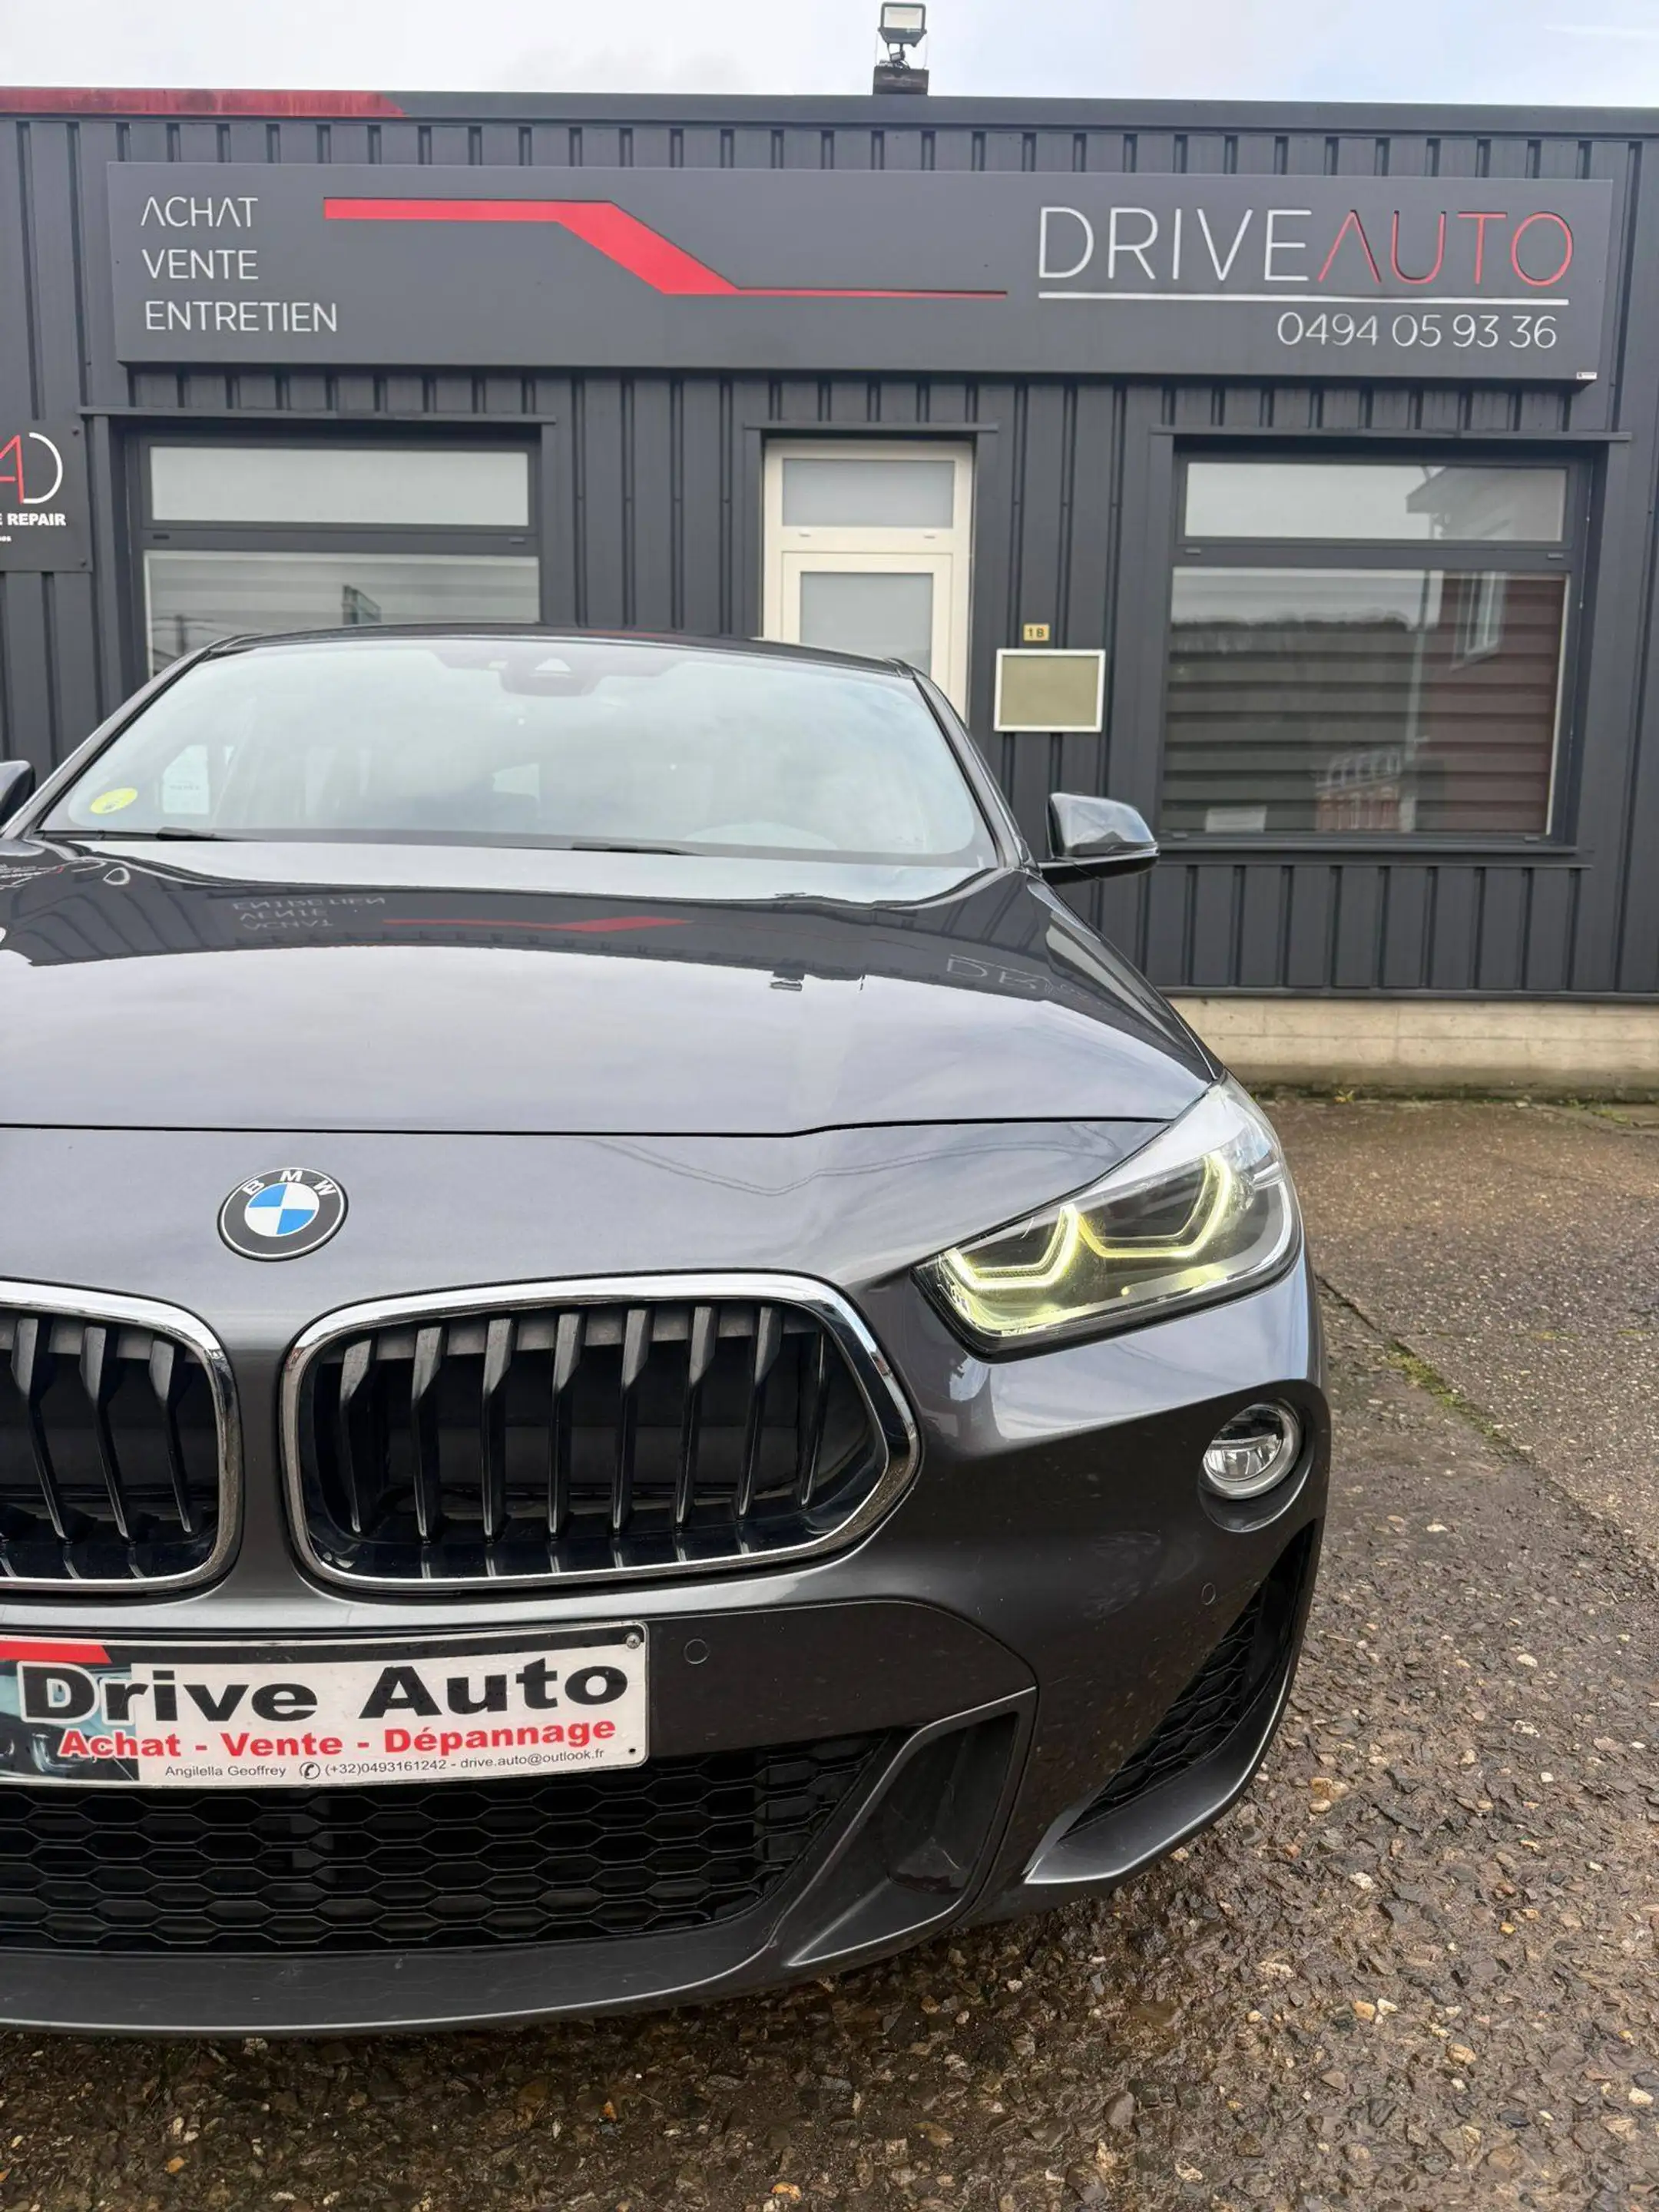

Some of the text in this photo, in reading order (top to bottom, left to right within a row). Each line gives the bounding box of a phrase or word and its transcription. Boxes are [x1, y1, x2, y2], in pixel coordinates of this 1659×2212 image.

[141, 196, 259, 227] ACHAT
[141, 248, 260, 280] VENTE
[144, 300, 338, 333] ENTRETIEN
[1277, 311, 1558, 349] 0494 05 93 36
[7, 512, 67, 526] REPAIR
[241, 1170, 336, 1197] BMW
[21, 1657, 628, 1721] Drive Auto
[58, 1729, 181, 1757] Achat
[220, 1732, 343, 1757] Vente
[384, 1720, 616, 1757] Dépannage
[164, 1765, 224, 1778] Angilella
[227, 1764, 286, 1778] Geoffrey
[325, 1760, 447, 1777] (+32)0493161242
[460, 1748, 604, 1769] drive.auto@outlook.fr
